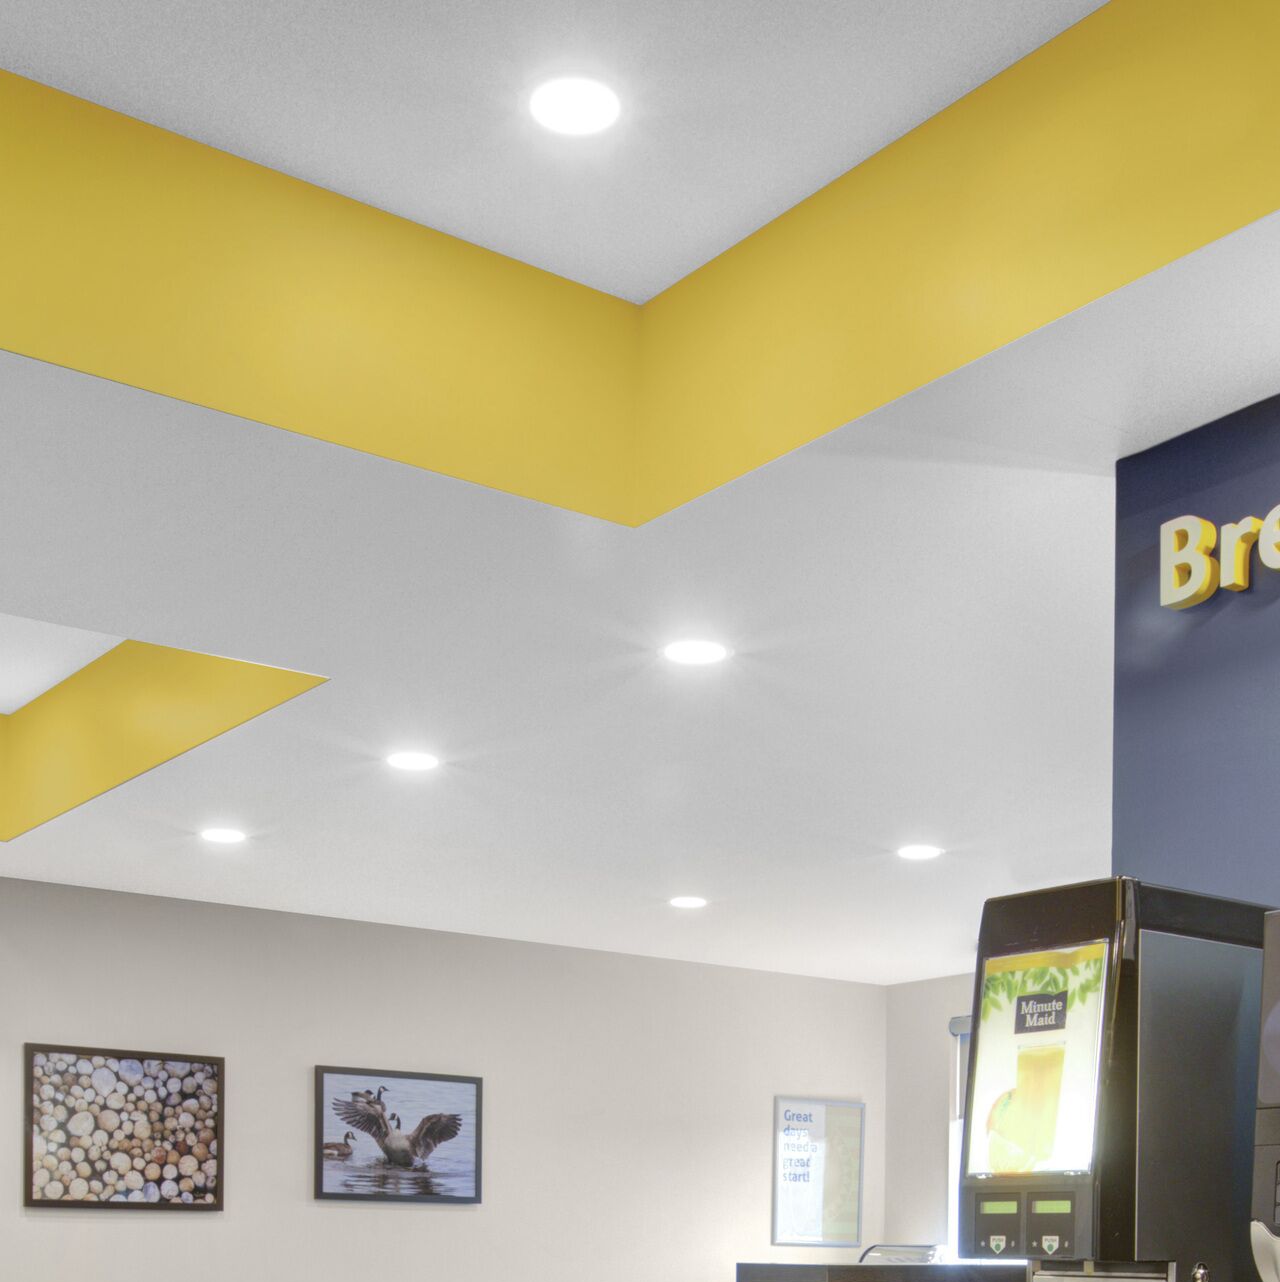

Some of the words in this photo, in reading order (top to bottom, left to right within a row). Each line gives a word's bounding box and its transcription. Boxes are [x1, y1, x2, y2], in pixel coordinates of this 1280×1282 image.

[1020, 1000, 1063, 1014] Minute
[1025, 1011, 1056, 1027] Maid
[784, 1109, 813, 1123] Great
[784, 1124, 809, 1140] days
[784, 1141, 808, 1152] need
[810, 1144, 818, 1153] a
[783, 1157, 810, 1170] great
[783, 1171, 810, 1182] start!
